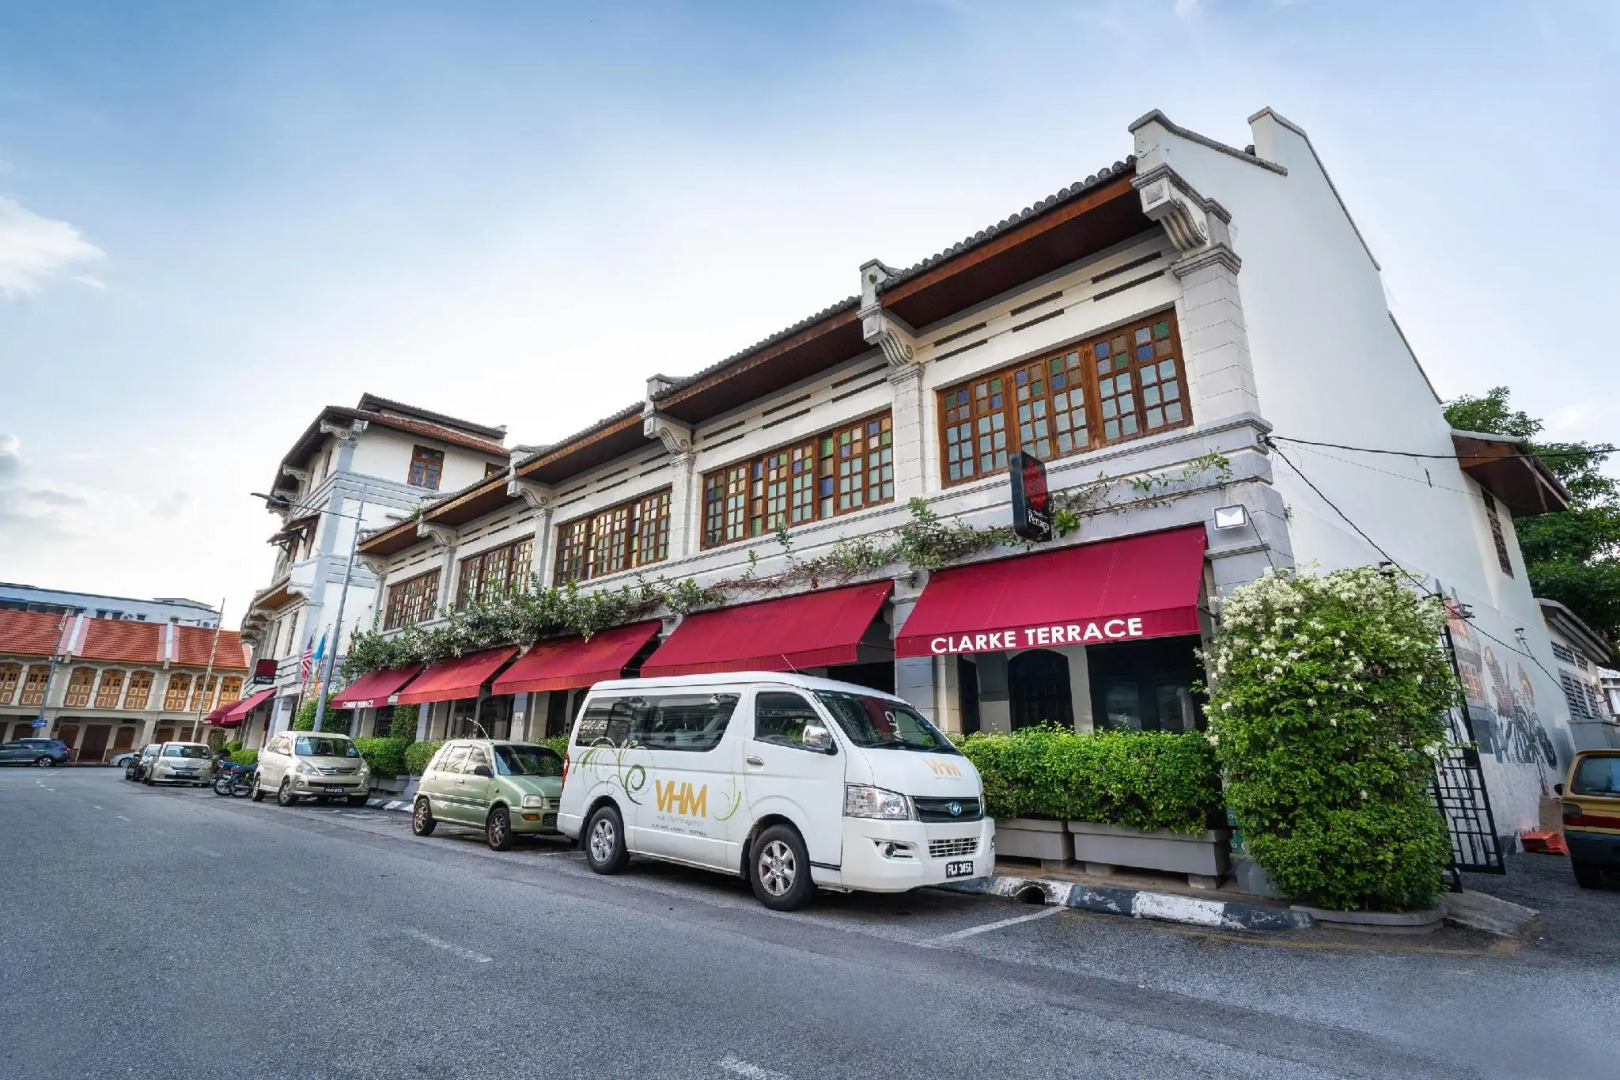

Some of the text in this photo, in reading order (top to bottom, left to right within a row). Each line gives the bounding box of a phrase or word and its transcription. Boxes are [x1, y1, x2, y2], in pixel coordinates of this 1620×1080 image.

[931, 617, 1143, 653] CLARKE TERRACE
[655, 779, 708, 818] VHM
